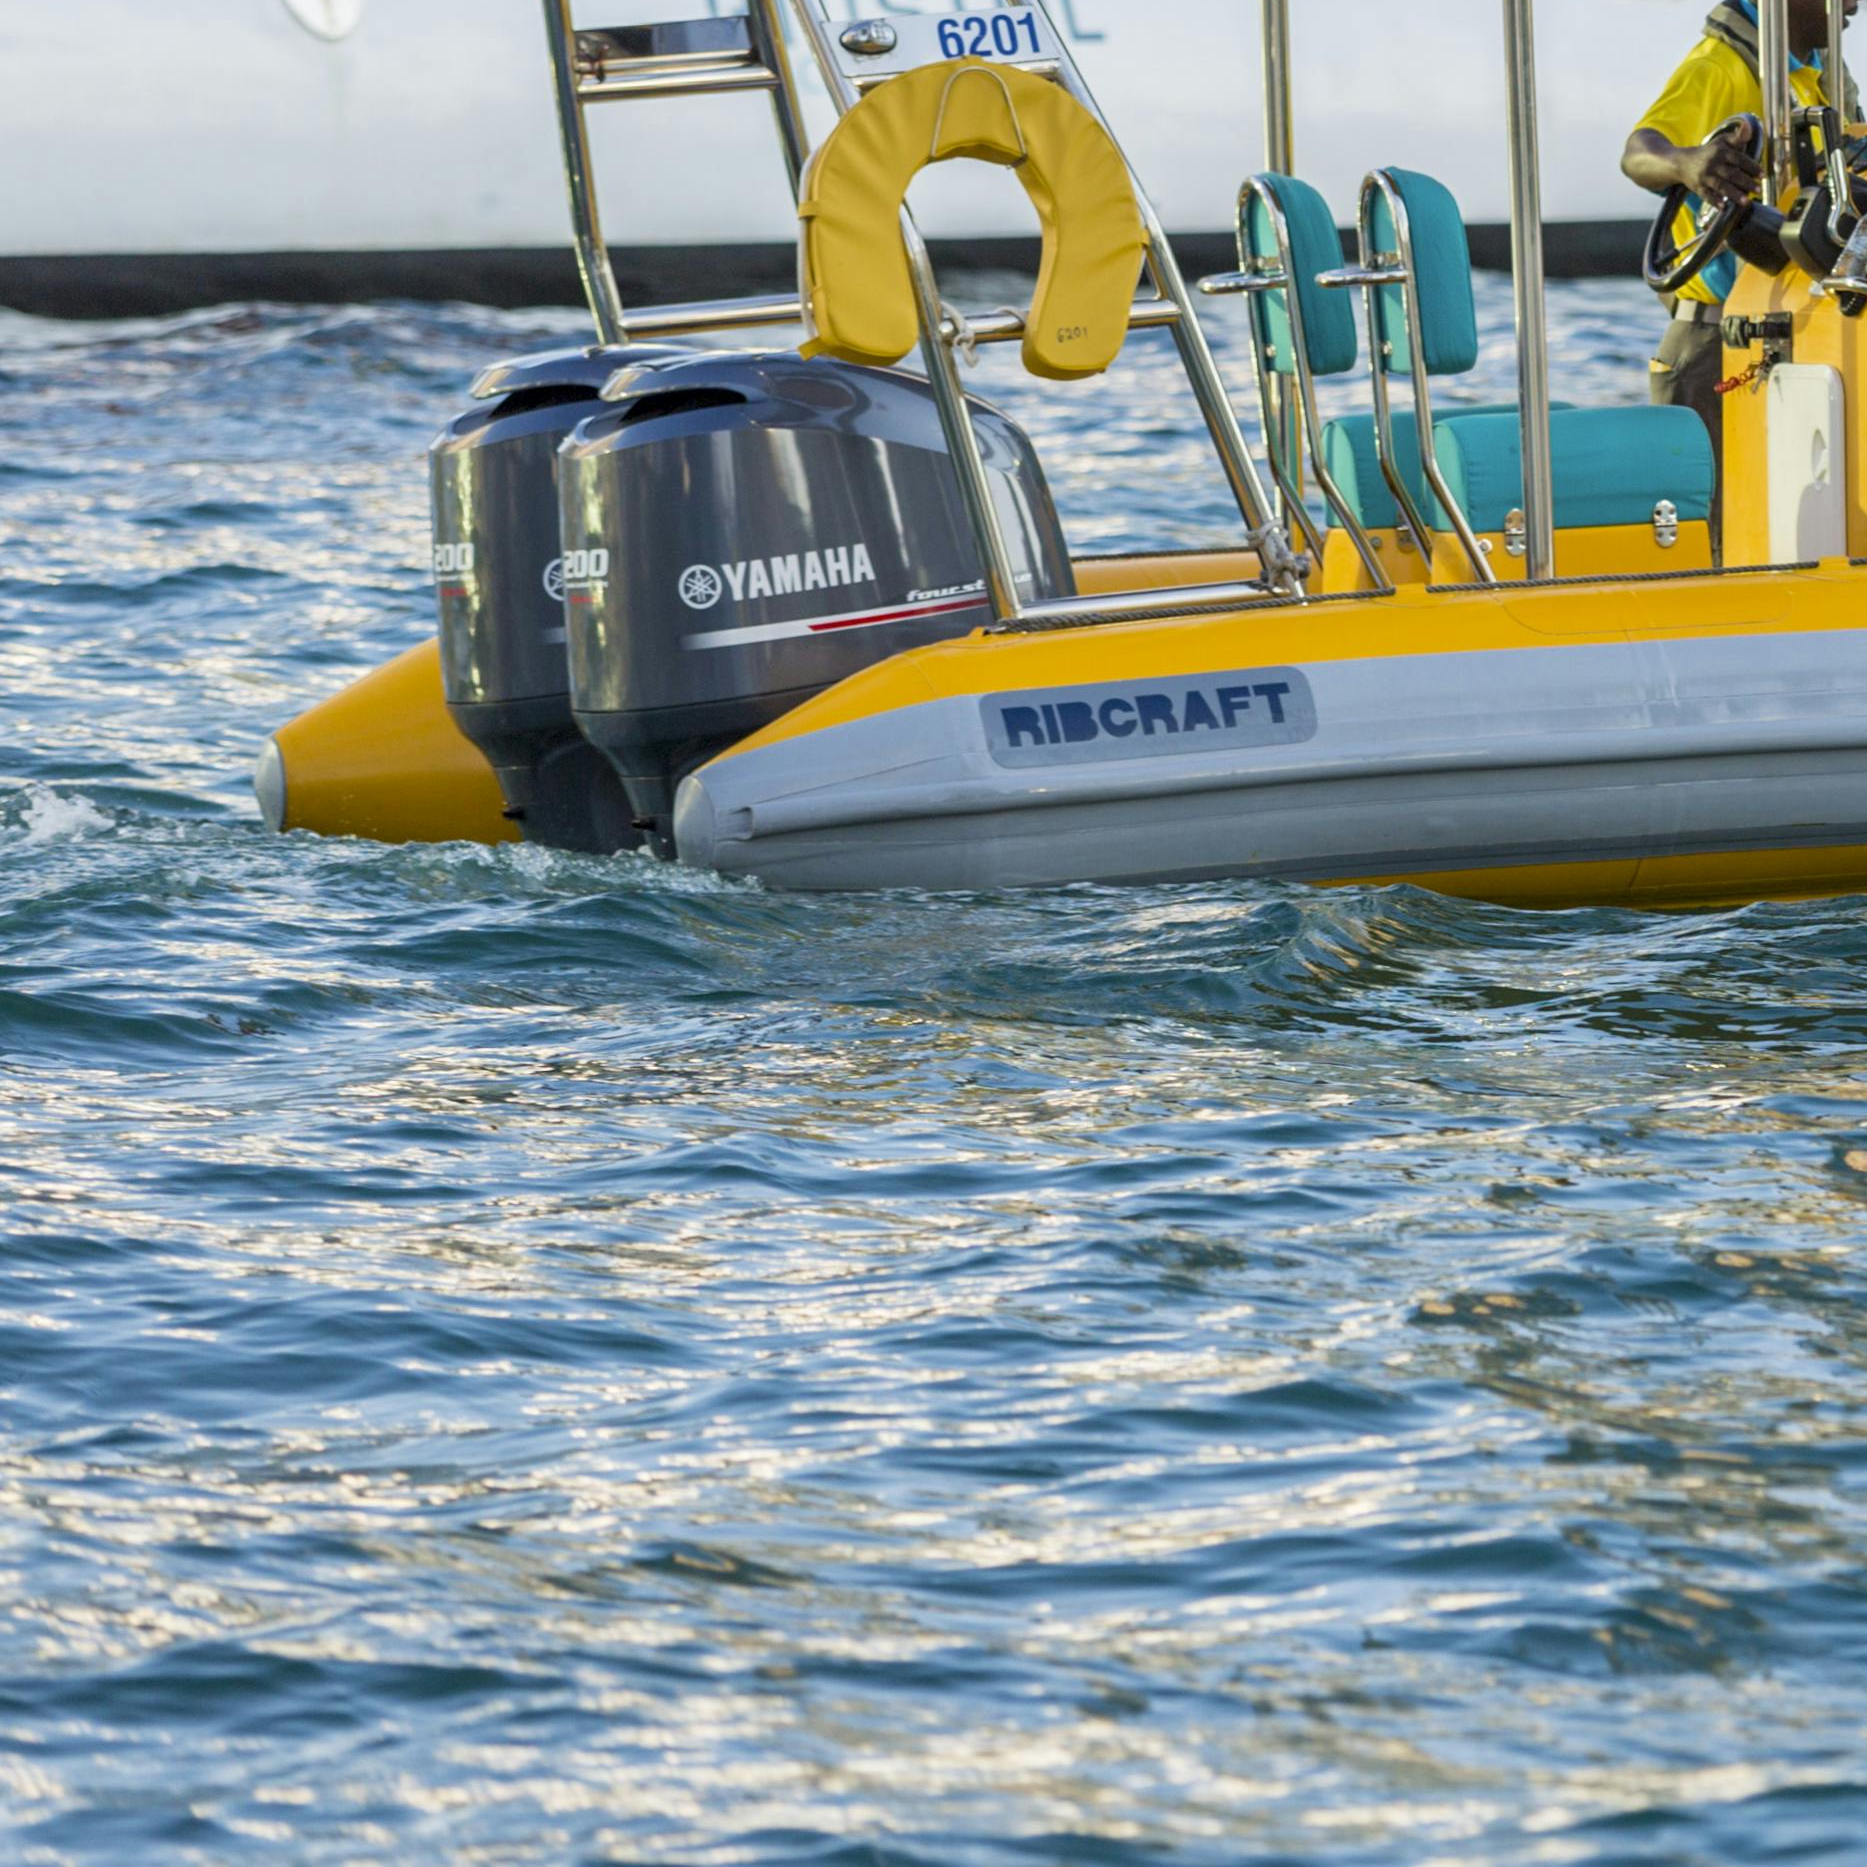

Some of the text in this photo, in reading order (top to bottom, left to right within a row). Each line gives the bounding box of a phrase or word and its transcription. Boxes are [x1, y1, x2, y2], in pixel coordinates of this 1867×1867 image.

[936, 11, 1041, 60] 6201
[1055, 325, 1088, 343] 6201
[433, 542, 475, 572] 200
[563, 547, 609, 580] 200
[720, 542, 877, 602] YAMAHA
[1000, 681, 1291, 749] RIBCRAFT
